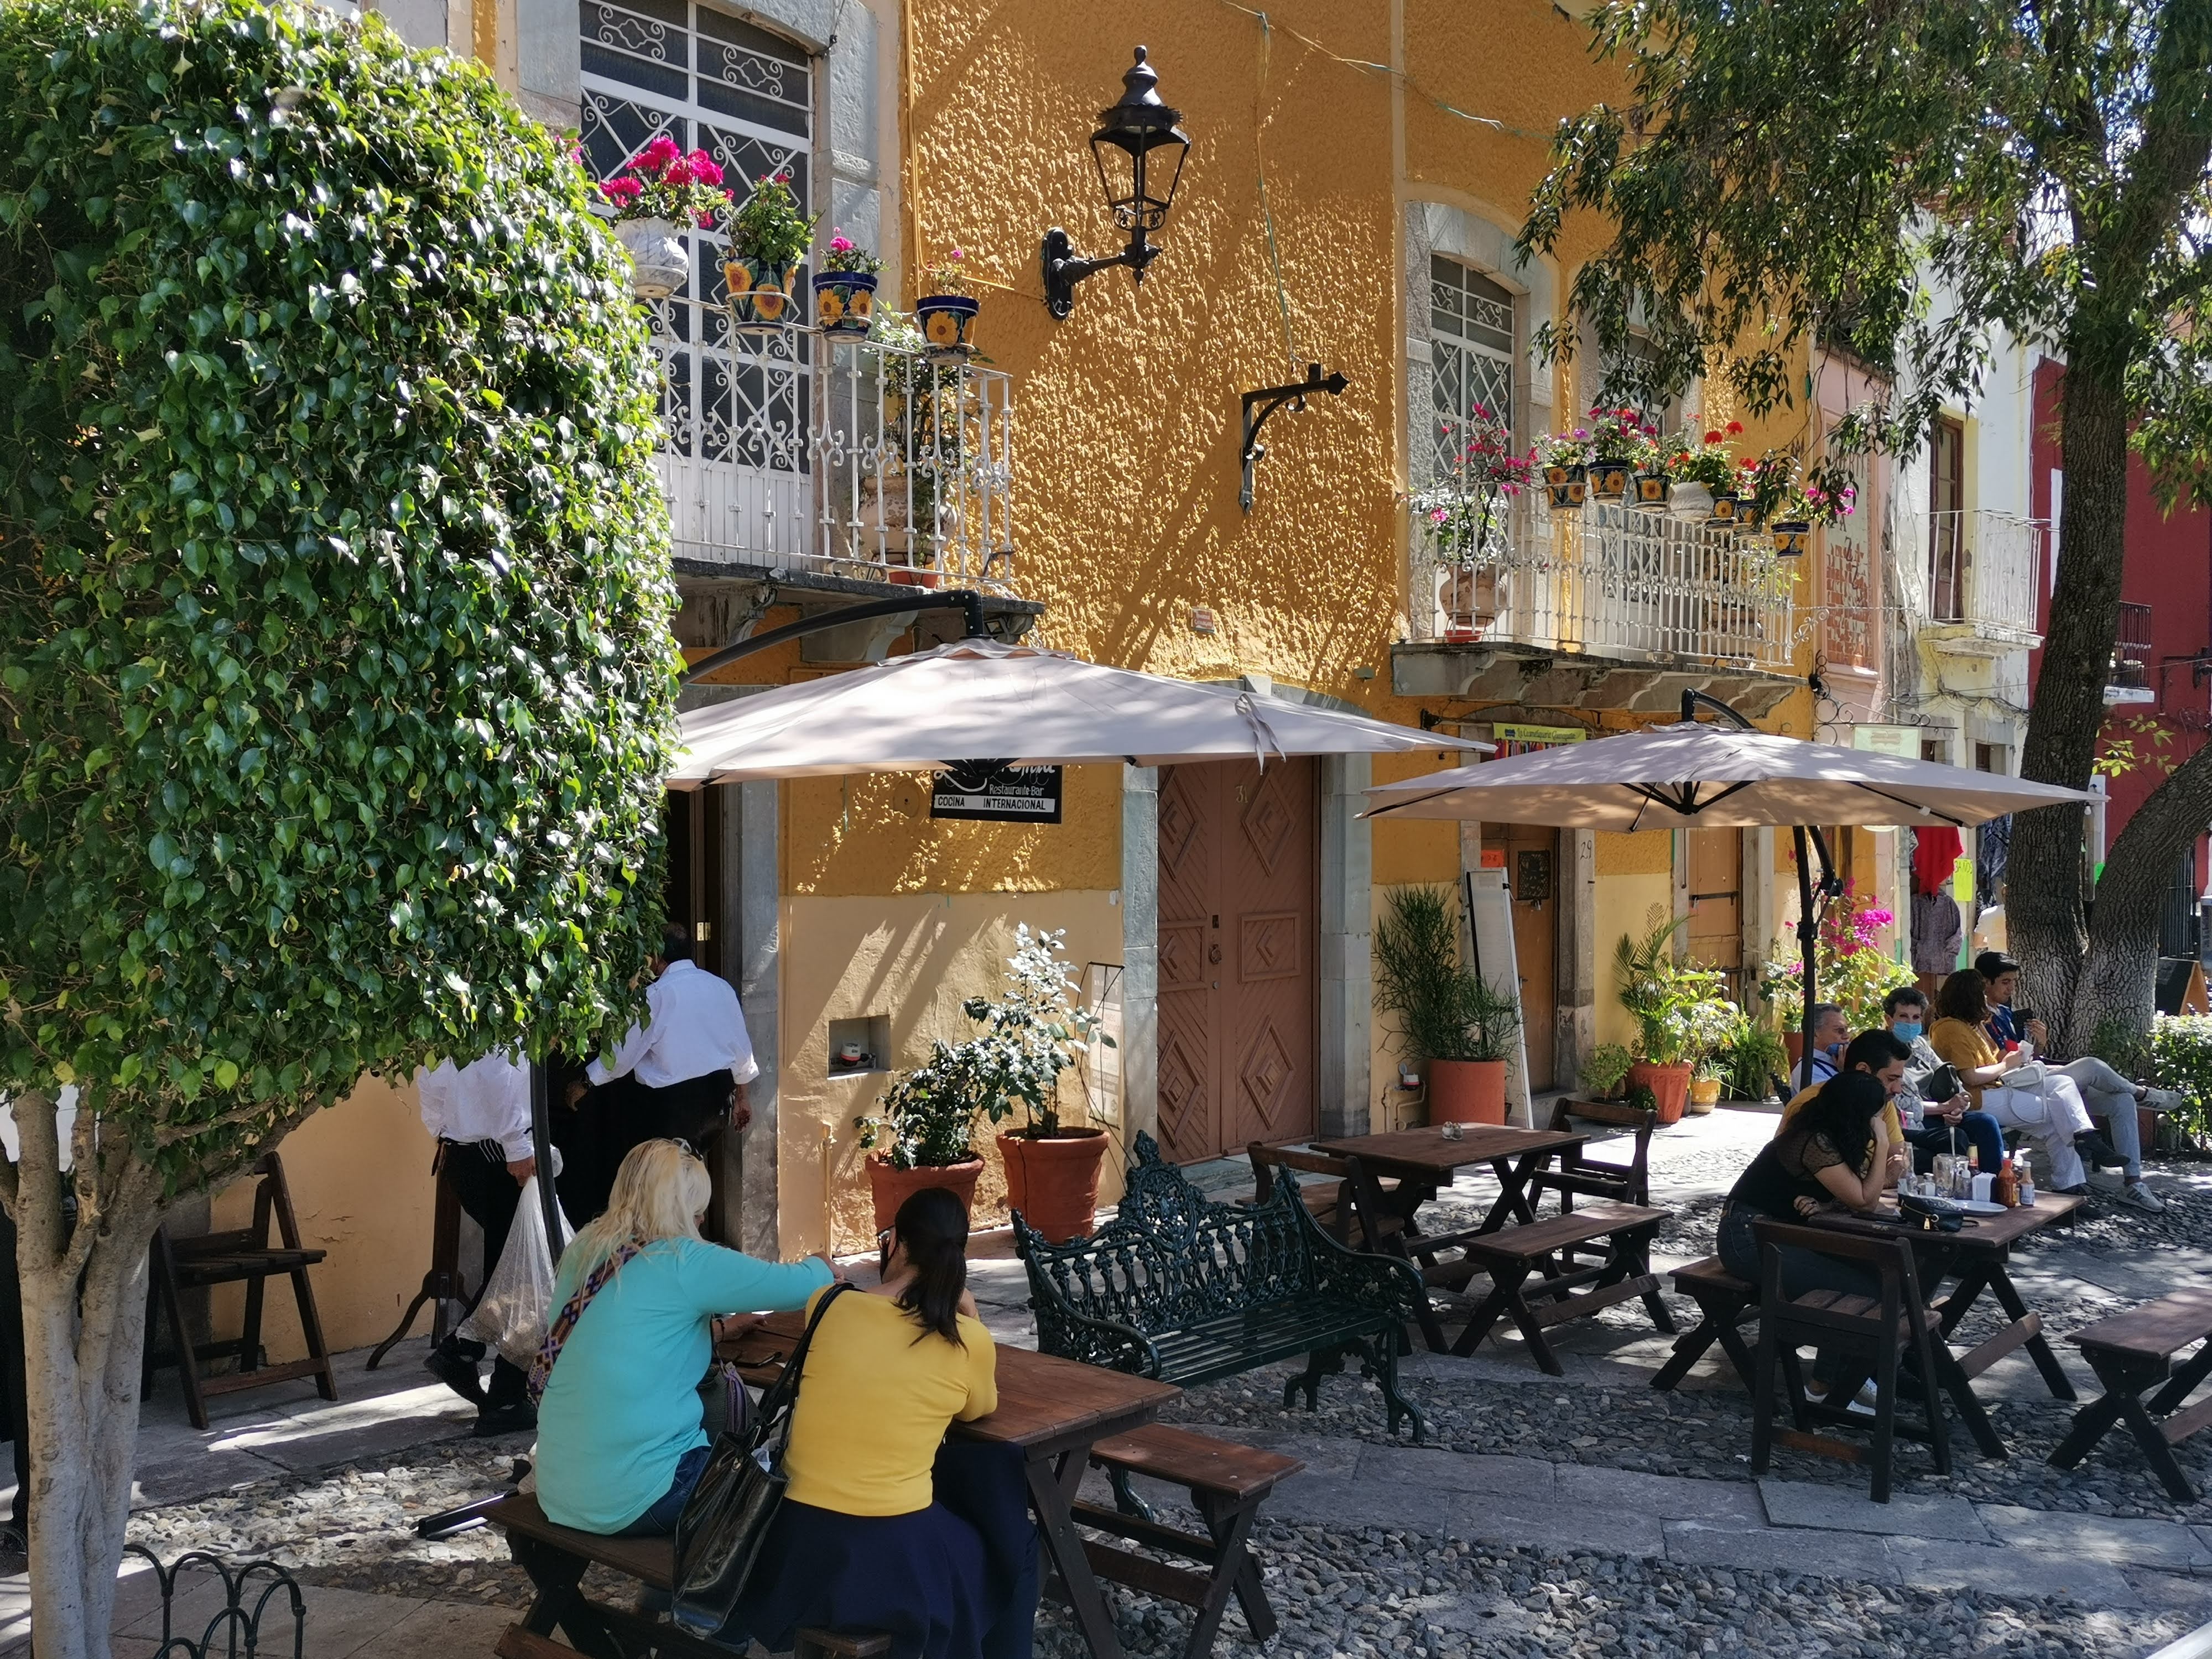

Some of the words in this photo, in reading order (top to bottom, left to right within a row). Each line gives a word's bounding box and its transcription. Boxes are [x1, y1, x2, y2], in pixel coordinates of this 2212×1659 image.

[989, 784, 1044, 796] Restaurante-Bar
[938, 796, 965, 807] COCINA
[983, 797, 1046, 810] INTERNACIONAL
[1580, 839, 1592, 860] 29
